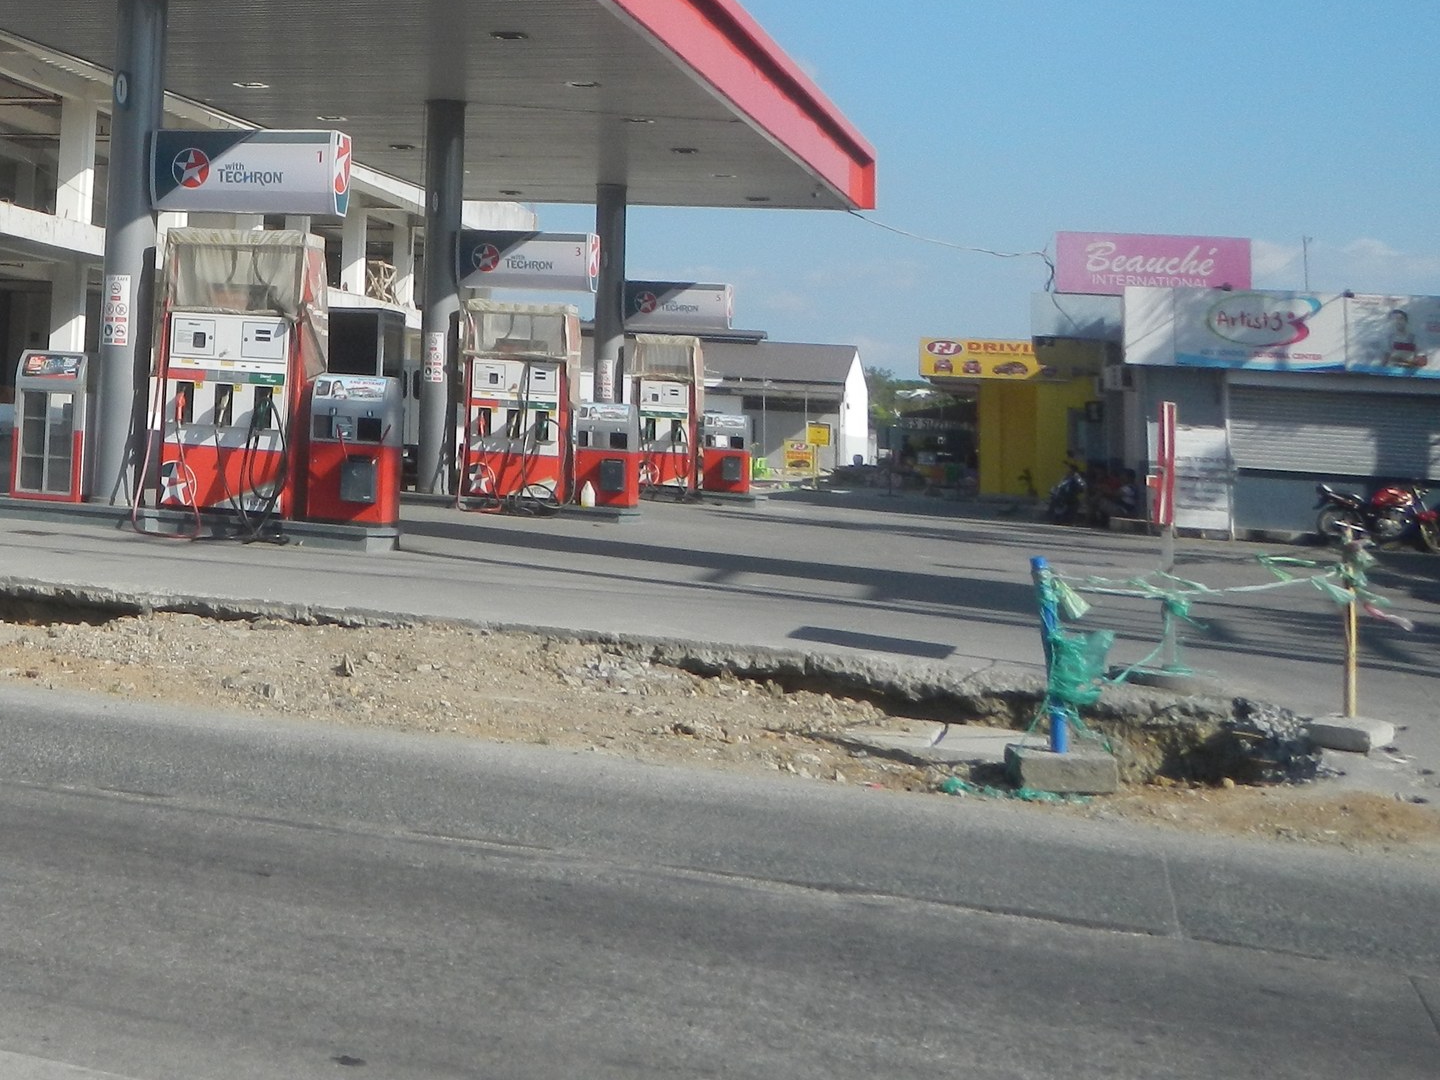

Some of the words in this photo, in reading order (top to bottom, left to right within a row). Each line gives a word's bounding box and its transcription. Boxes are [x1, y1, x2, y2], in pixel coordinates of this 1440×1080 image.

[317, 151, 322, 163] 1
[225, 162, 245, 171] with
[217, 169, 283, 186] TECHRON
[575, 247, 581, 257] 3
[1085, 241, 1218, 276] Beauché
[505, 259, 553, 271] TECHRON
[1092, 274, 1207, 288] INTERNATIONAL
[662, 304, 699, 313] TECHRON
[1293, 352, 1322, 361] CENTER
